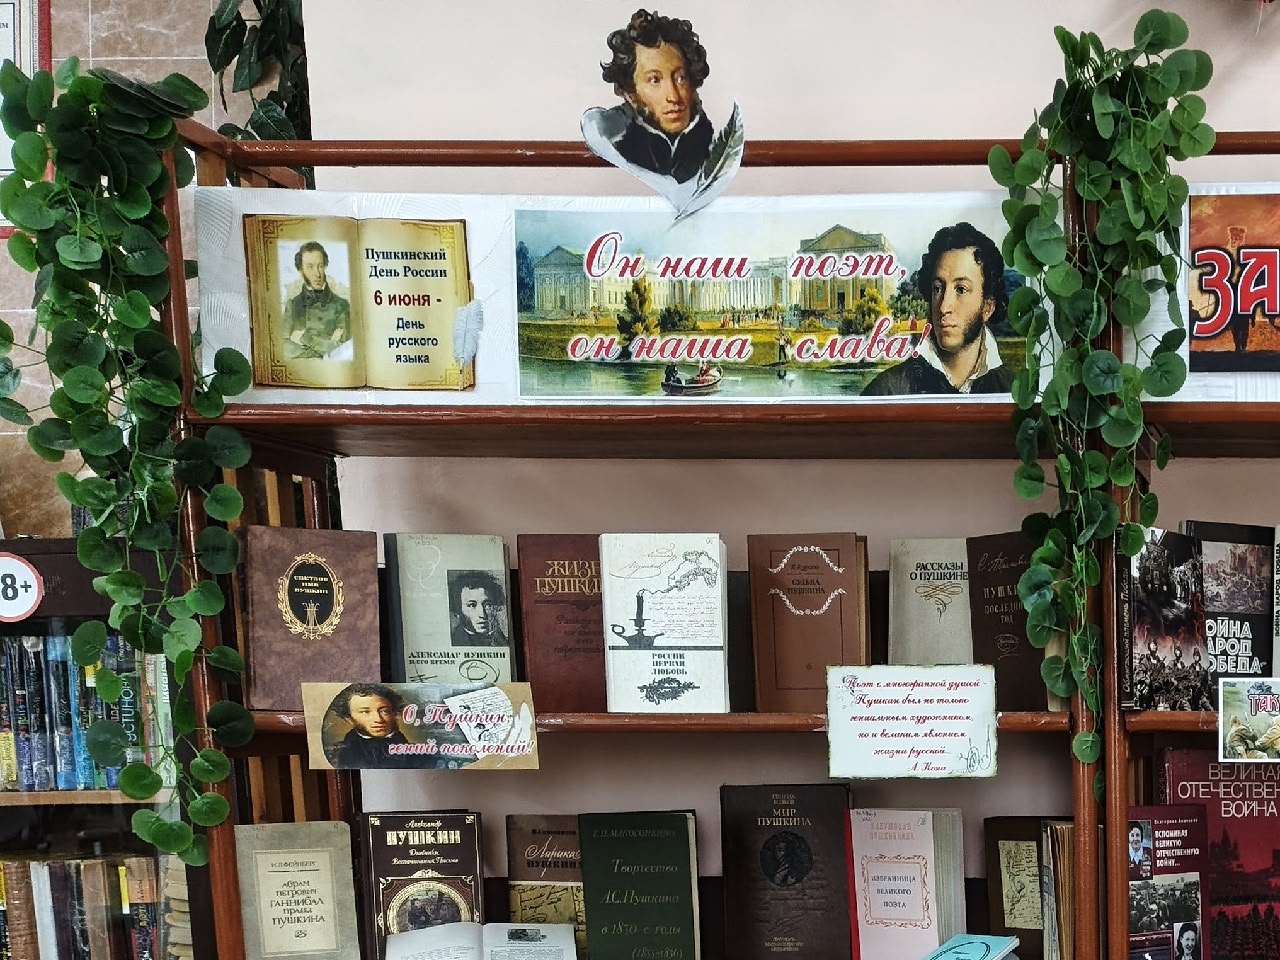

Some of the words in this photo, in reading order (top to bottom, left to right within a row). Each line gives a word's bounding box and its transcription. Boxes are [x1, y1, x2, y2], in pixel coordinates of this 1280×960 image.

[365, 247, 446, 263] Пушкинский
[586, 232, 644, 278] Он
[657, 256, 751, 278] наш
[792, 253, 907, 282] поэт,
[369, 266, 399, 279] День
[404, 266, 448, 278] России
[374, 291, 383, 306] 6
[388, 293, 431, 307] июня
[1194, 249, 1279, 336] ЗА
[396, 317, 425, 331] День
[388, 335, 438, 349] русского
[569, 336, 619, 360] он
[632, 336, 751, 360] наша
[796, 317, 930, 359] слава!
[396, 353, 429, 365] языка
[916, 562, 963, 571] РАССКАЗЫ
[910, 572, 917, 580] О
[920, 572, 968, 581] ПУШКИНЕ
[408, 651, 461, 659] АЛЕКСАНДР
[464, 651, 506, 659] ПУШКИН
[1248, 694, 1280, 715] ТАК
[403, 704, 420, 726] О,
[773, 808, 796, 817] МИР
[1221, 801, 1278, 818] ВОЙНА
[758, 817, 811, 827] ПУШКИНА
[386, 831, 460, 845] ПУШКИН
[612, 859, 678, 875] Творчество
[871, 874, 916, 883] ИЗБРАННИЦА
[877, 888, 912, 896] ВЕЛИКОГО
[883, 900, 906, 909] ПОЭТА
